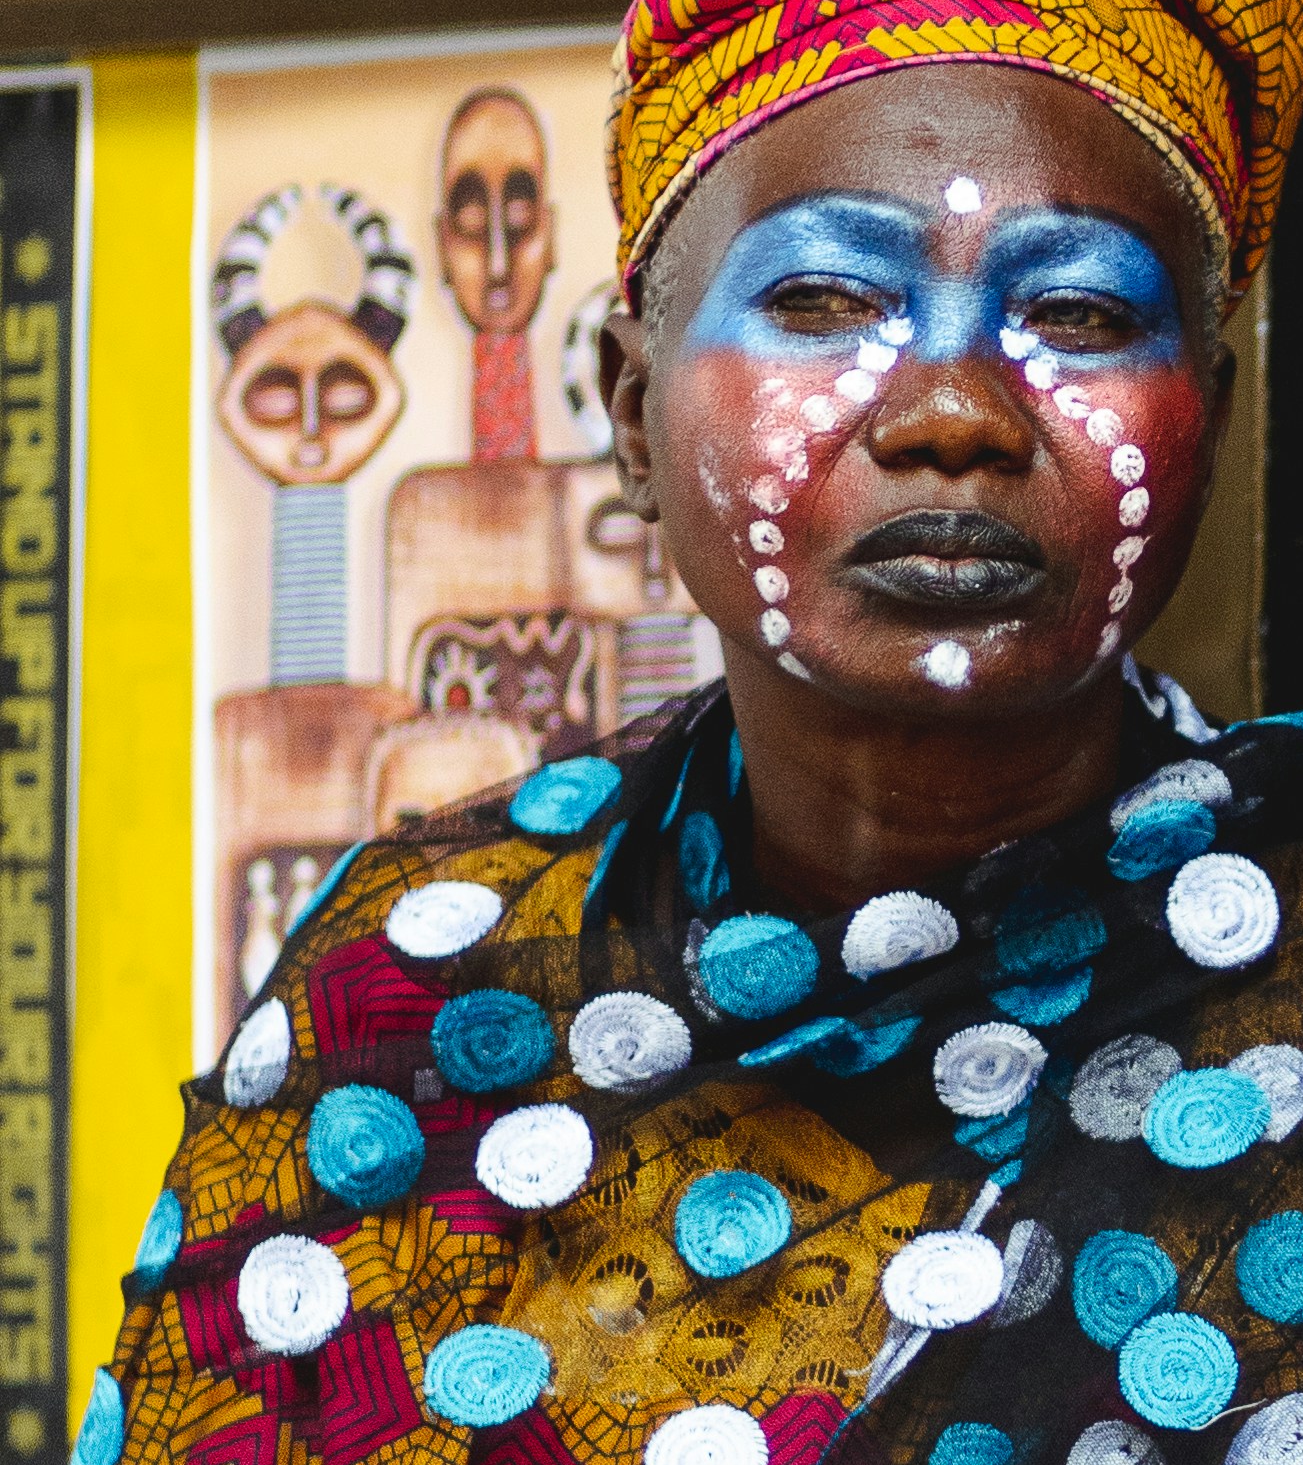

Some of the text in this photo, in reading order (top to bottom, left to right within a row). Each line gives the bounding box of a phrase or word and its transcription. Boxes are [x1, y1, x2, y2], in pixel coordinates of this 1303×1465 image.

[2, 301, 60, 571] STAND
[2, 575, 58, 692] UP
[0, 696, 56, 864] FOR
